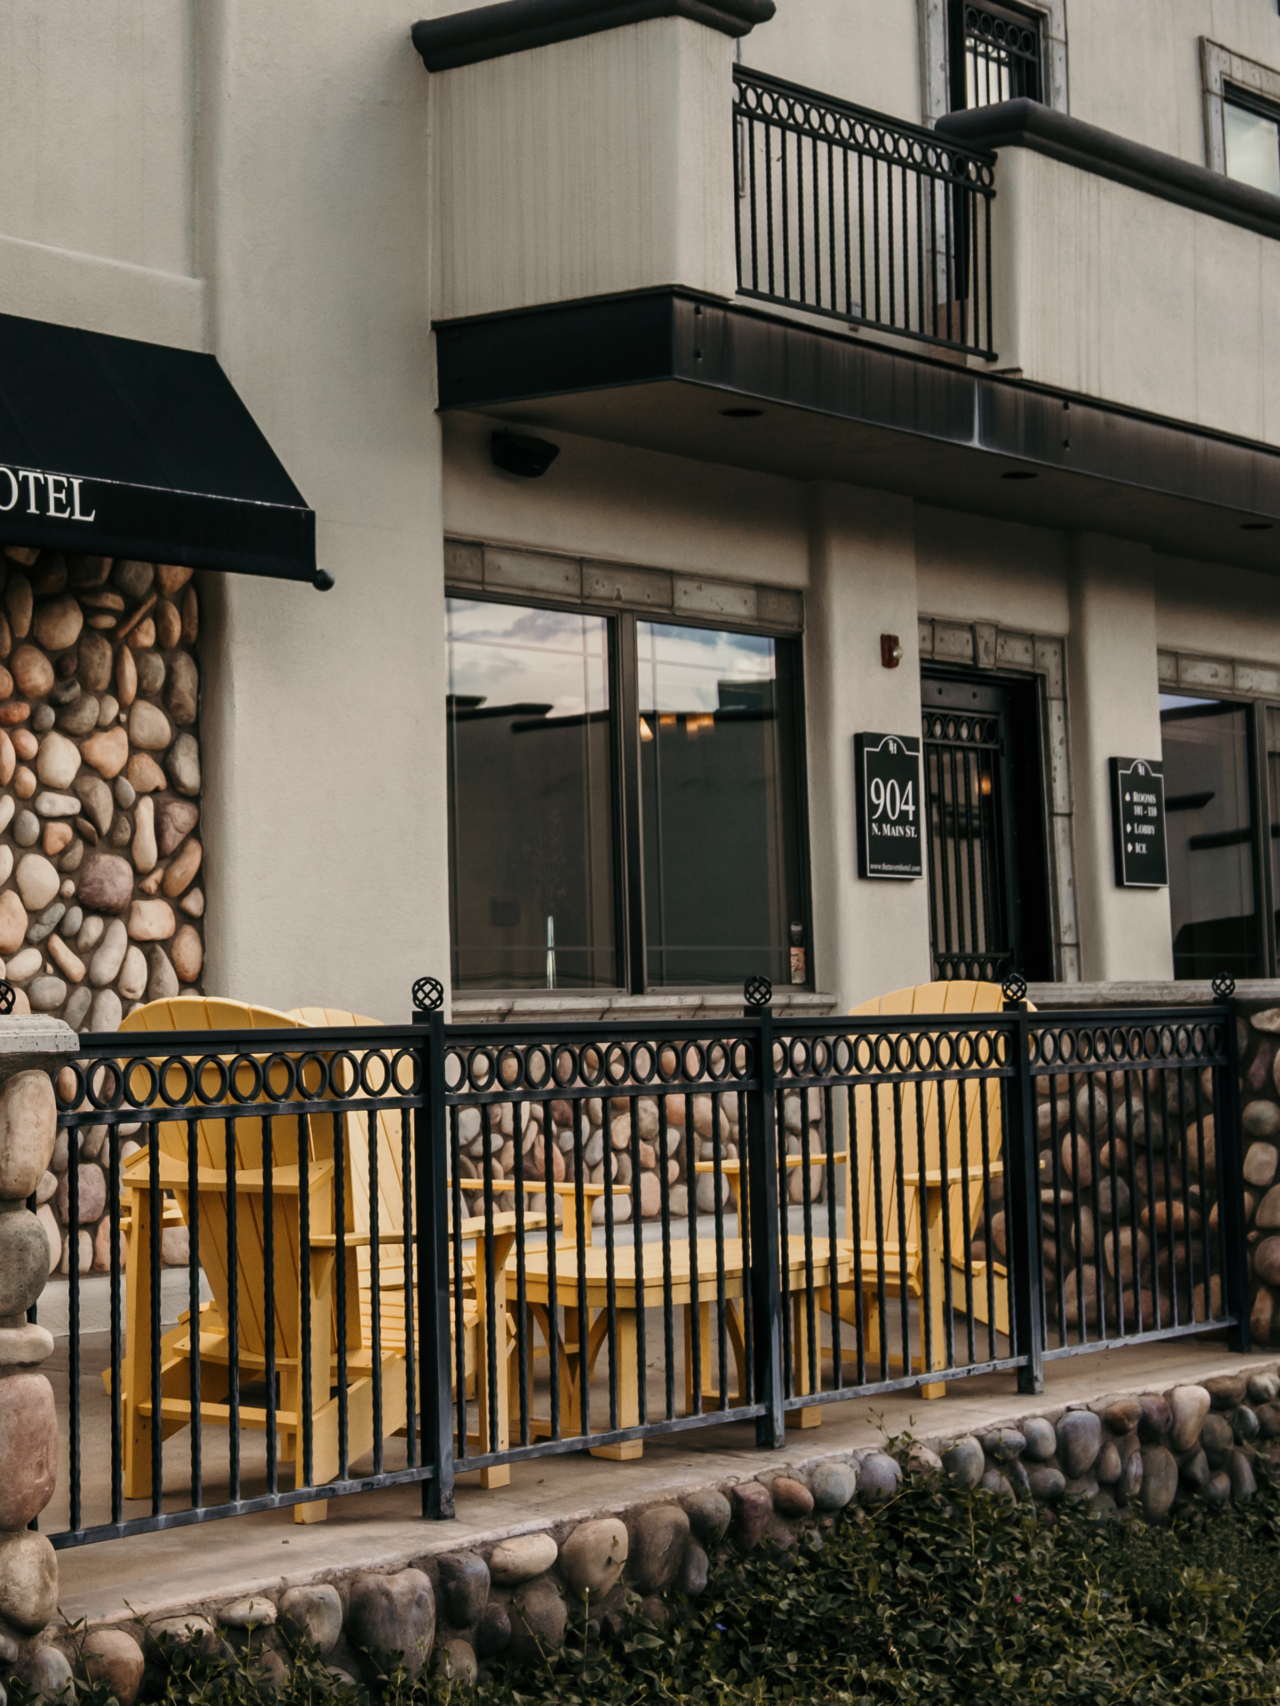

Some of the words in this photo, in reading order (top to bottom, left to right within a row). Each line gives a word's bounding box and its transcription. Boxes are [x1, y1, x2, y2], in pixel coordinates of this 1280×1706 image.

[870, 777, 916, 821] 904
[1133, 791, 1157, 804] ROOMS
[871, 823, 881, 836] N.
[882, 825, 905, 837] MAIN
[1134, 822, 1156, 835] LOBBY
[1135, 842, 1147, 854] ICE
